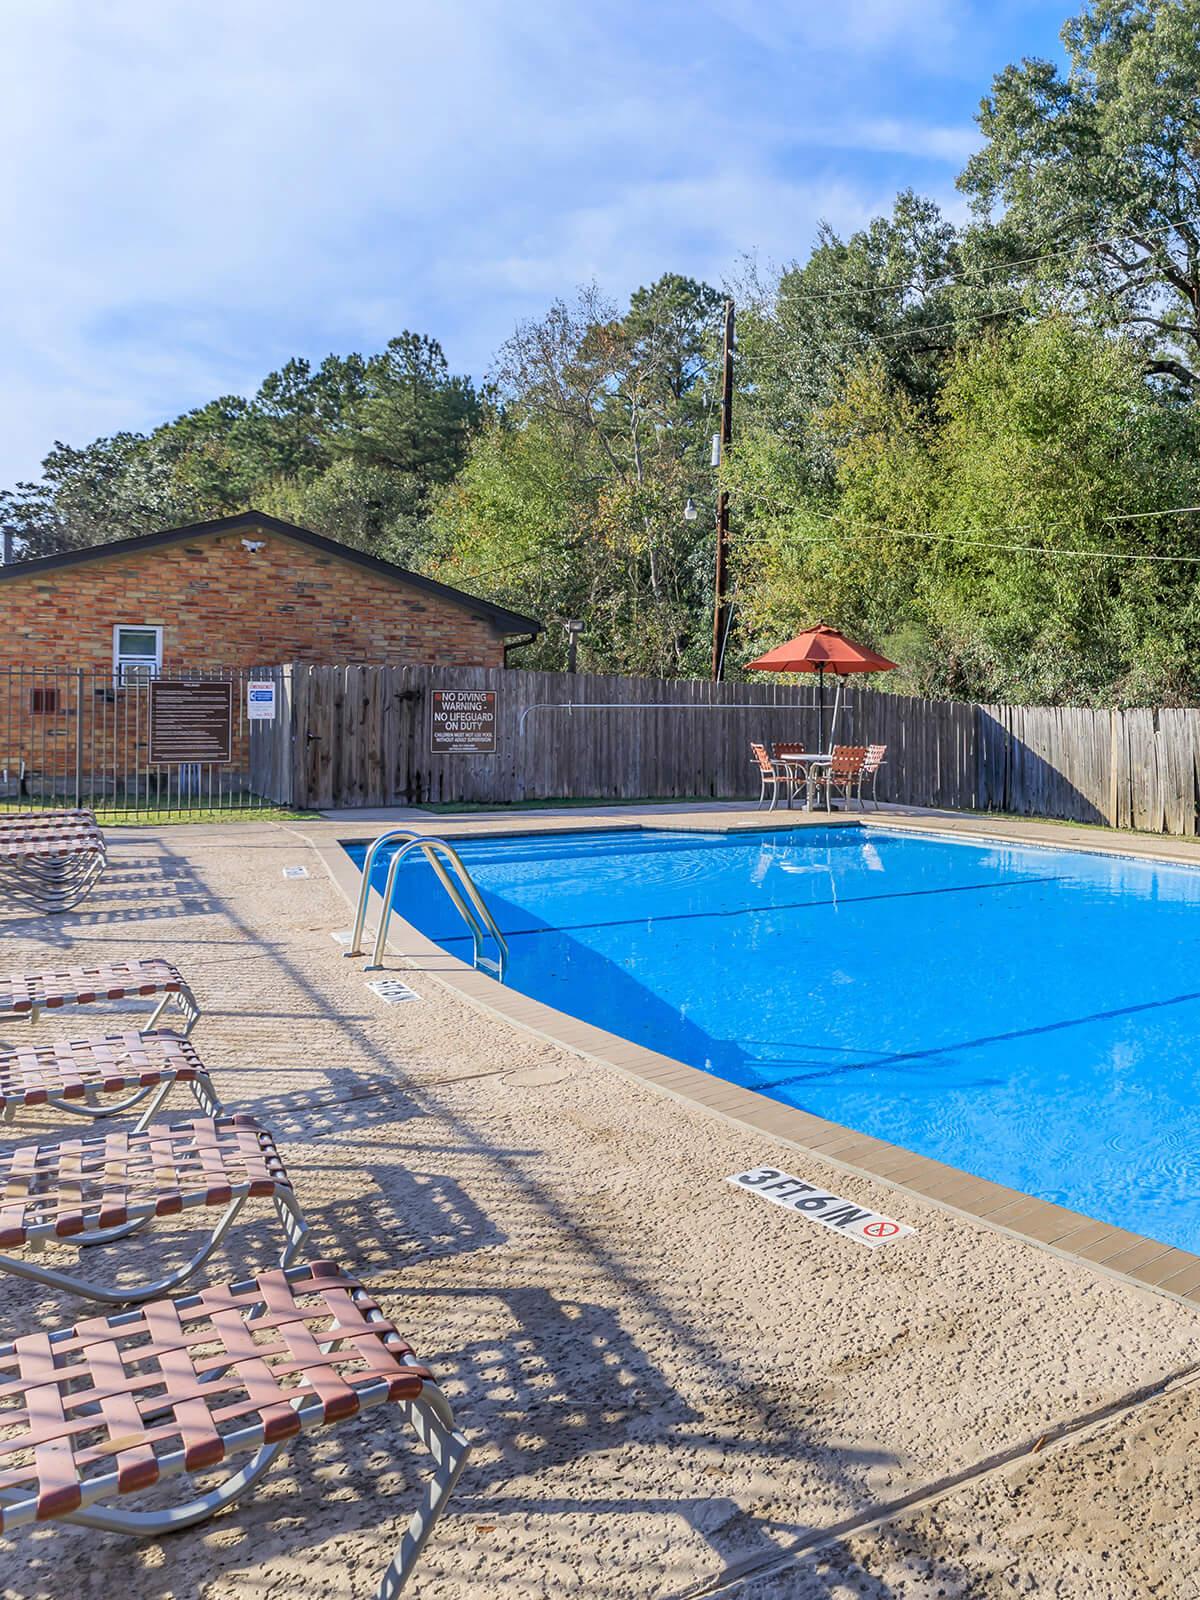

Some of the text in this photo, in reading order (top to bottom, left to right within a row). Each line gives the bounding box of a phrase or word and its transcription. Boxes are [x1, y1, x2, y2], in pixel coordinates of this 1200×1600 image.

[442, 692, 487, 702] NO DIVING
[441, 702, 482, 711] WARNING
[434, 712, 494, 721] NO LIFEGUARD
[445, 721, 483, 731] ON DUTY
[738, 1170, 781, 1186] 3
[794, 1196, 839, 1211] 6
